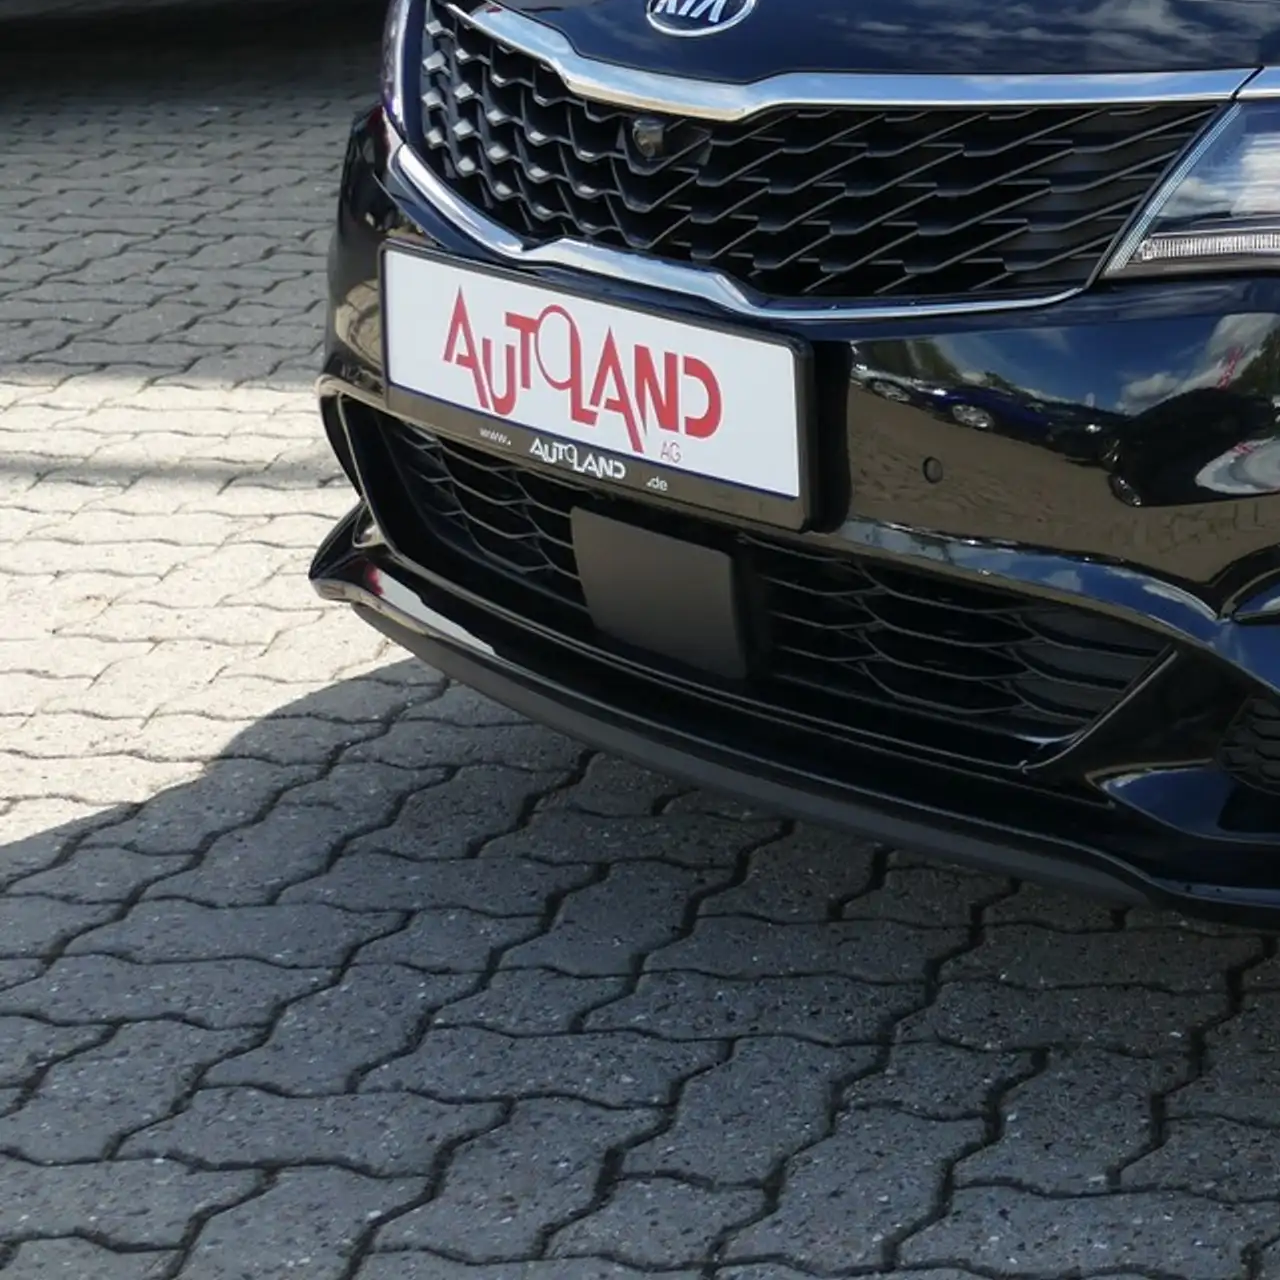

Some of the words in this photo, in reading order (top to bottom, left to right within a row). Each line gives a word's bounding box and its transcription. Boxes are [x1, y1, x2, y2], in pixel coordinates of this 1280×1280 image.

[442, 284, 722, 454] AUTOLAND
[529, 437, 626, 480] AUTOLAND
[660, 439, 682, 463] AG
